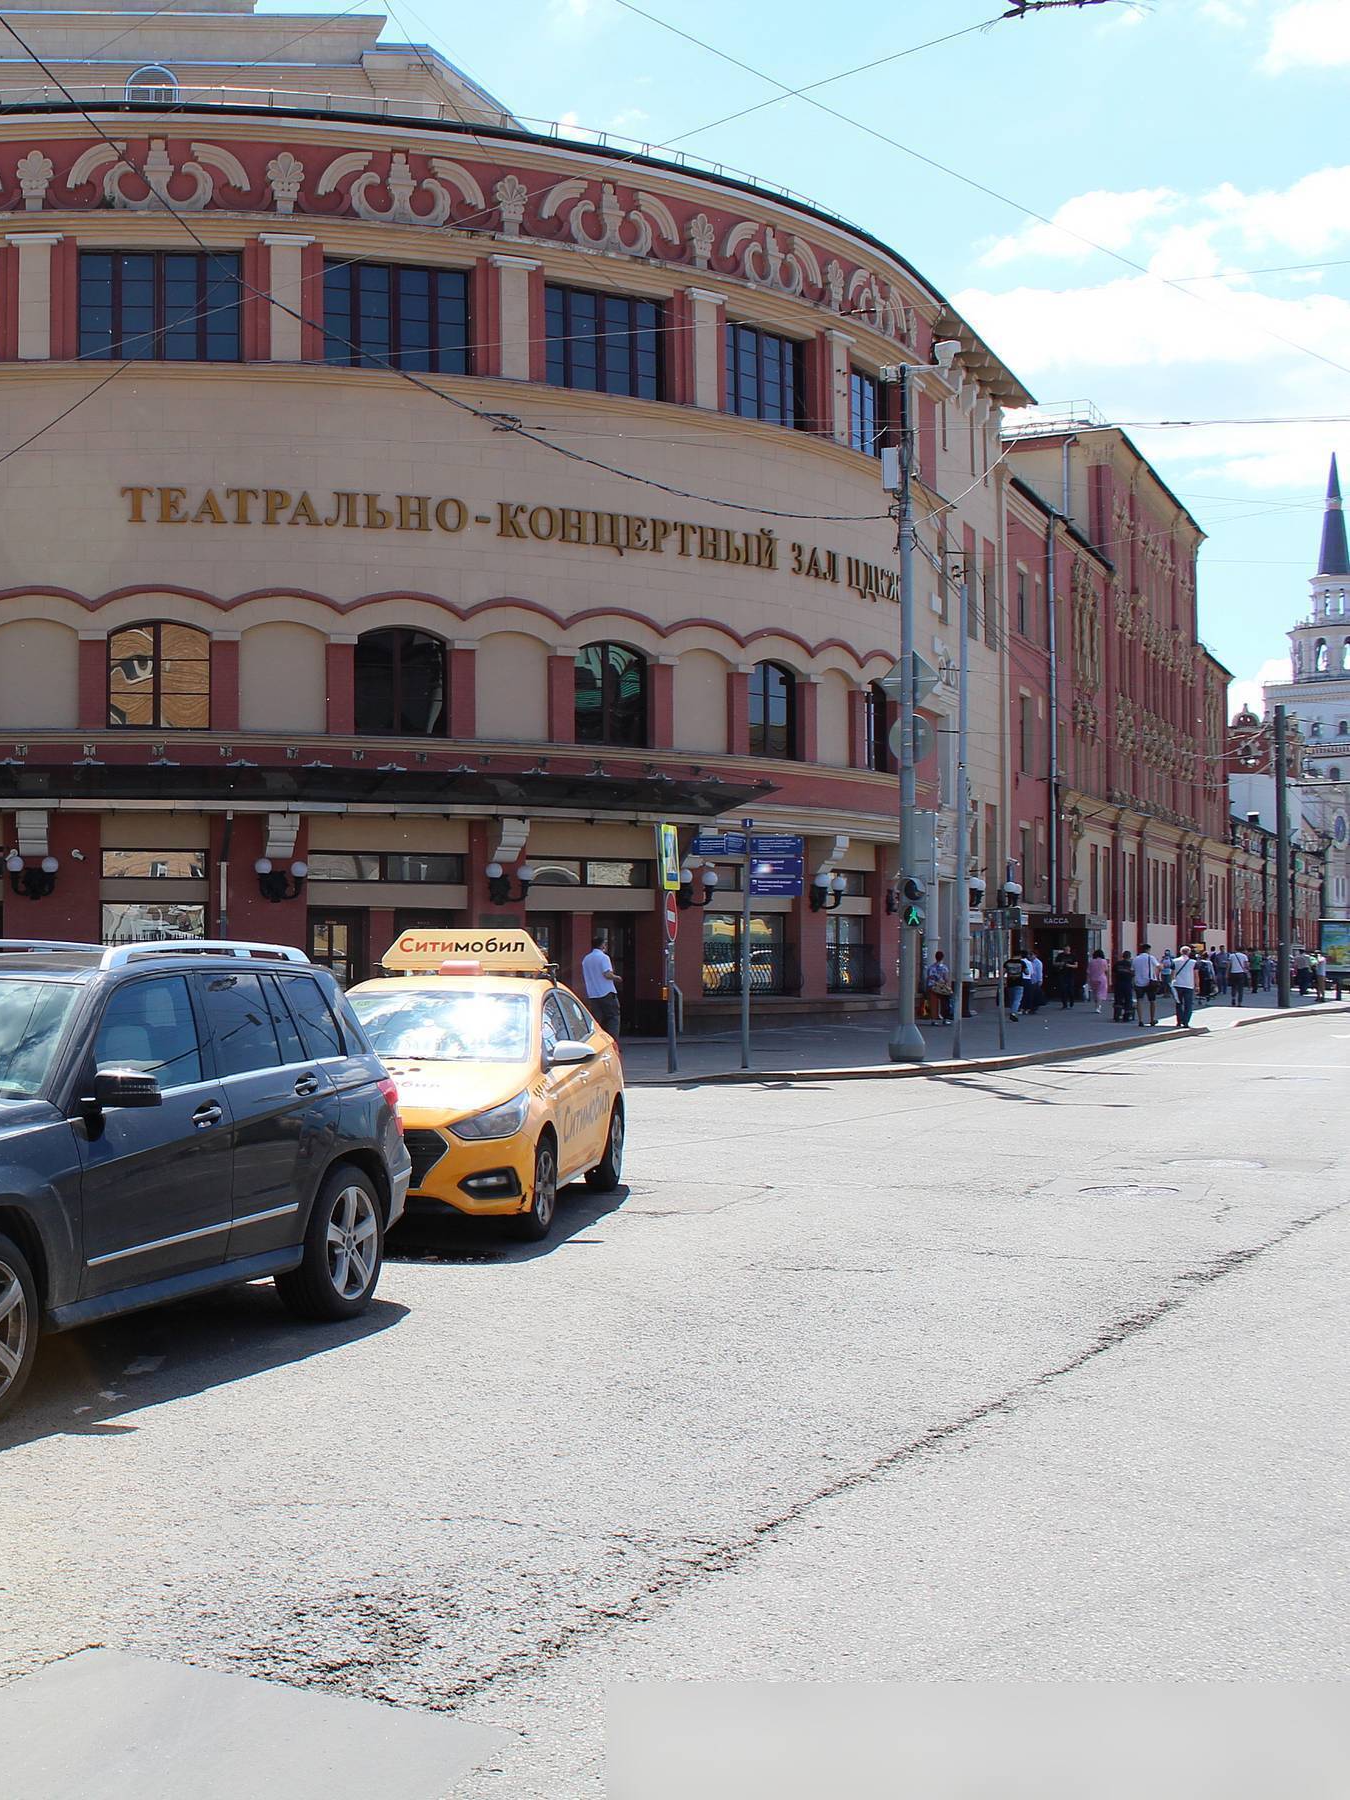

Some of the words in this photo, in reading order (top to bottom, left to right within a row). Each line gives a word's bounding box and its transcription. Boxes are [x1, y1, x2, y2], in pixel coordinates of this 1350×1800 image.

[120, 485, 779, 571] ТЕАТРАЛЬНО-КОНЦЕРТНЫЙ
[790, 541, 840, 584] ЗАЛ
[399, 937, 525, 953] Ситимобил
